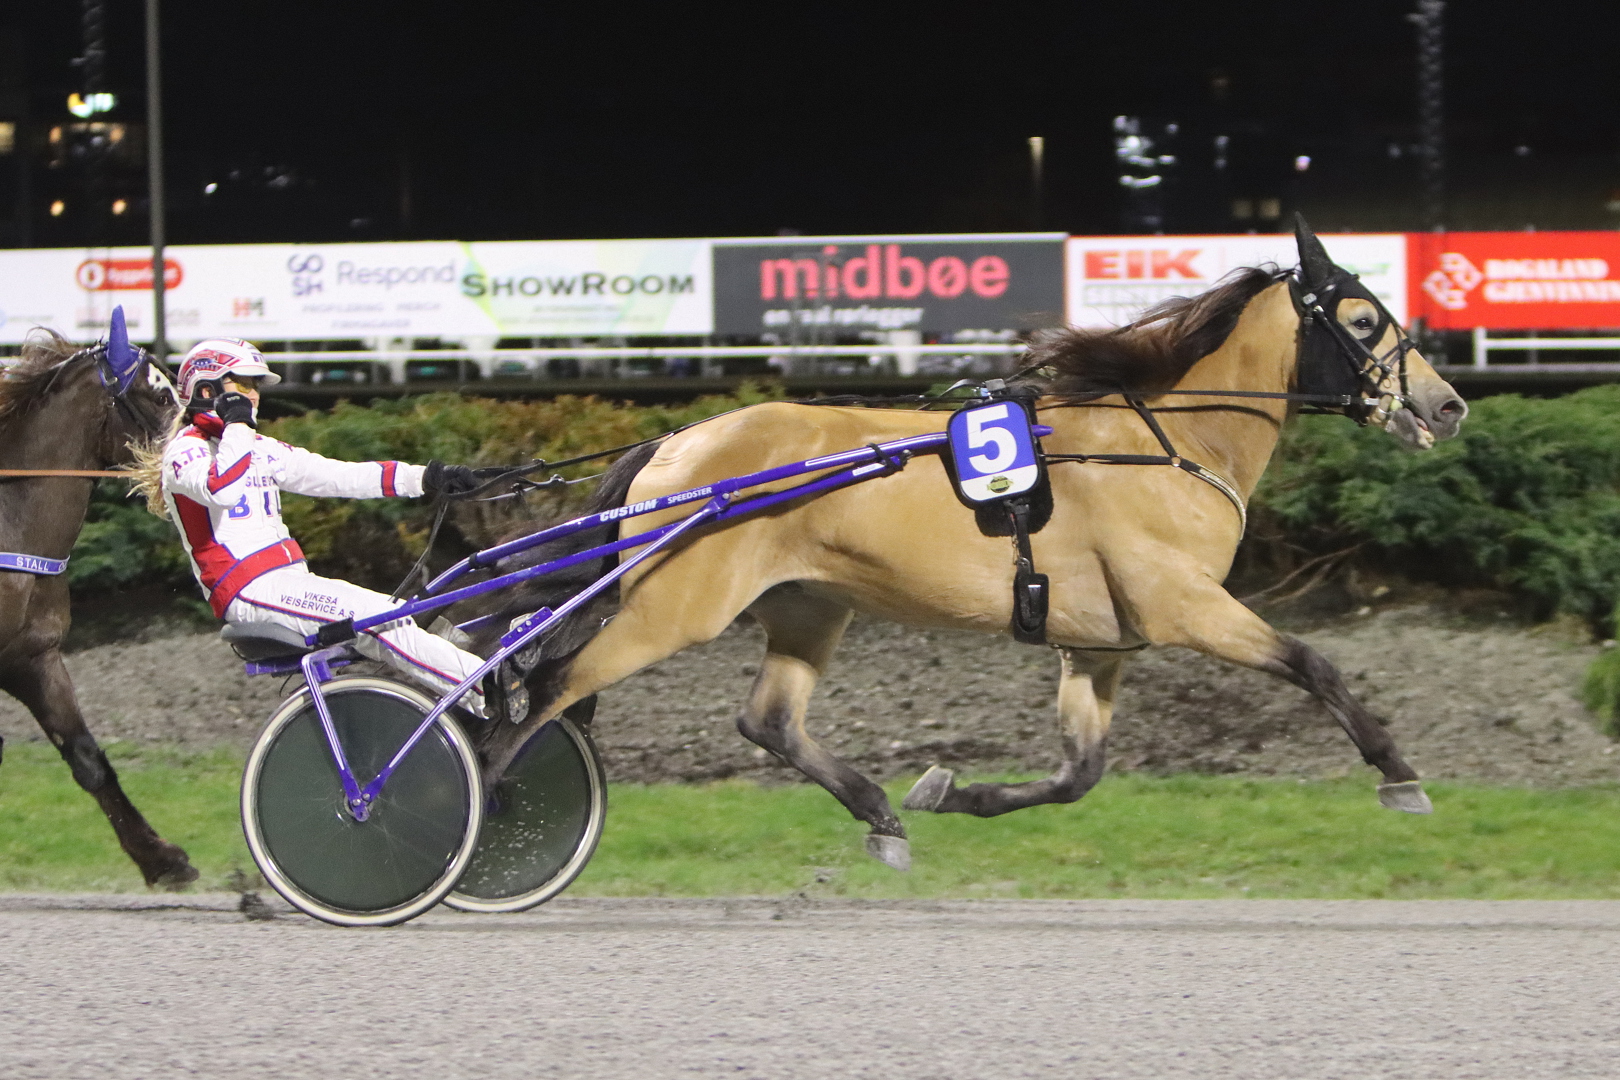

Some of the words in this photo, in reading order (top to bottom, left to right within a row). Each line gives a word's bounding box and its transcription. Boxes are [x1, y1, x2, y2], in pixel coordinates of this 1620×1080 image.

[337, 258, 457, 290] Respond
[760, 244, 1010, 300] midbøe
[1084, 250, 1205, 280] EIK
[967, 404, 1018, 474] 5
[600, 499, 657, 522] CUSTOM
[667, 486, 713, 505] SPEEDSTER
[16, 556, 49, 572] STALL
[280, 594, 337, 615] VEISERVICE
